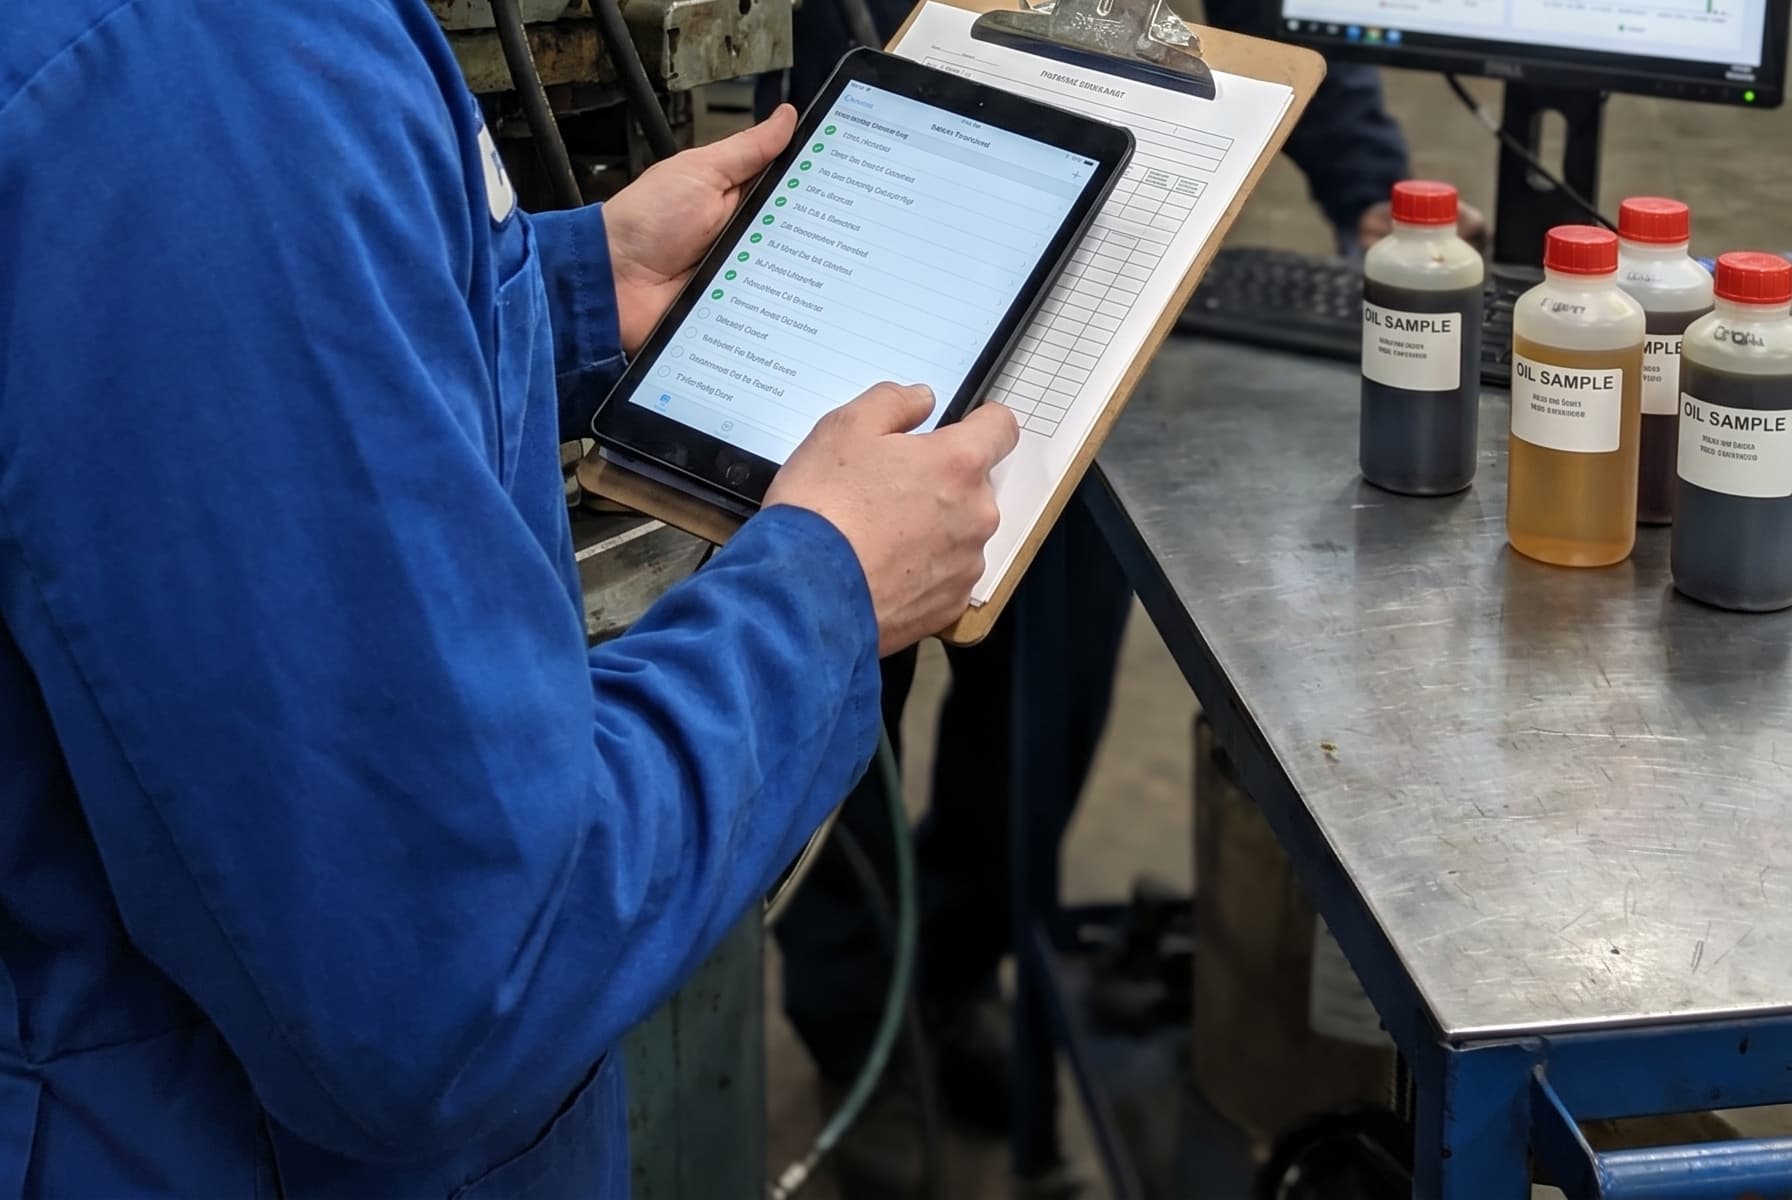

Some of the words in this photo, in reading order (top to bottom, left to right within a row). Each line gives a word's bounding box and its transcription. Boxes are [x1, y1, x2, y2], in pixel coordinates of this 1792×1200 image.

[1365, 307, 1381, 326] OIL
[1384, 315, 1451, 333] SAMPLE
[1643, 341, 1682, 355] MPLE
[1516, 362, 1536, 382] OIL
[1539, 370, 1614, 390] SAMPLE
[1684, 401, 1705, 423] OIL
[1708, 411, 1786, 432] SAMPLE
